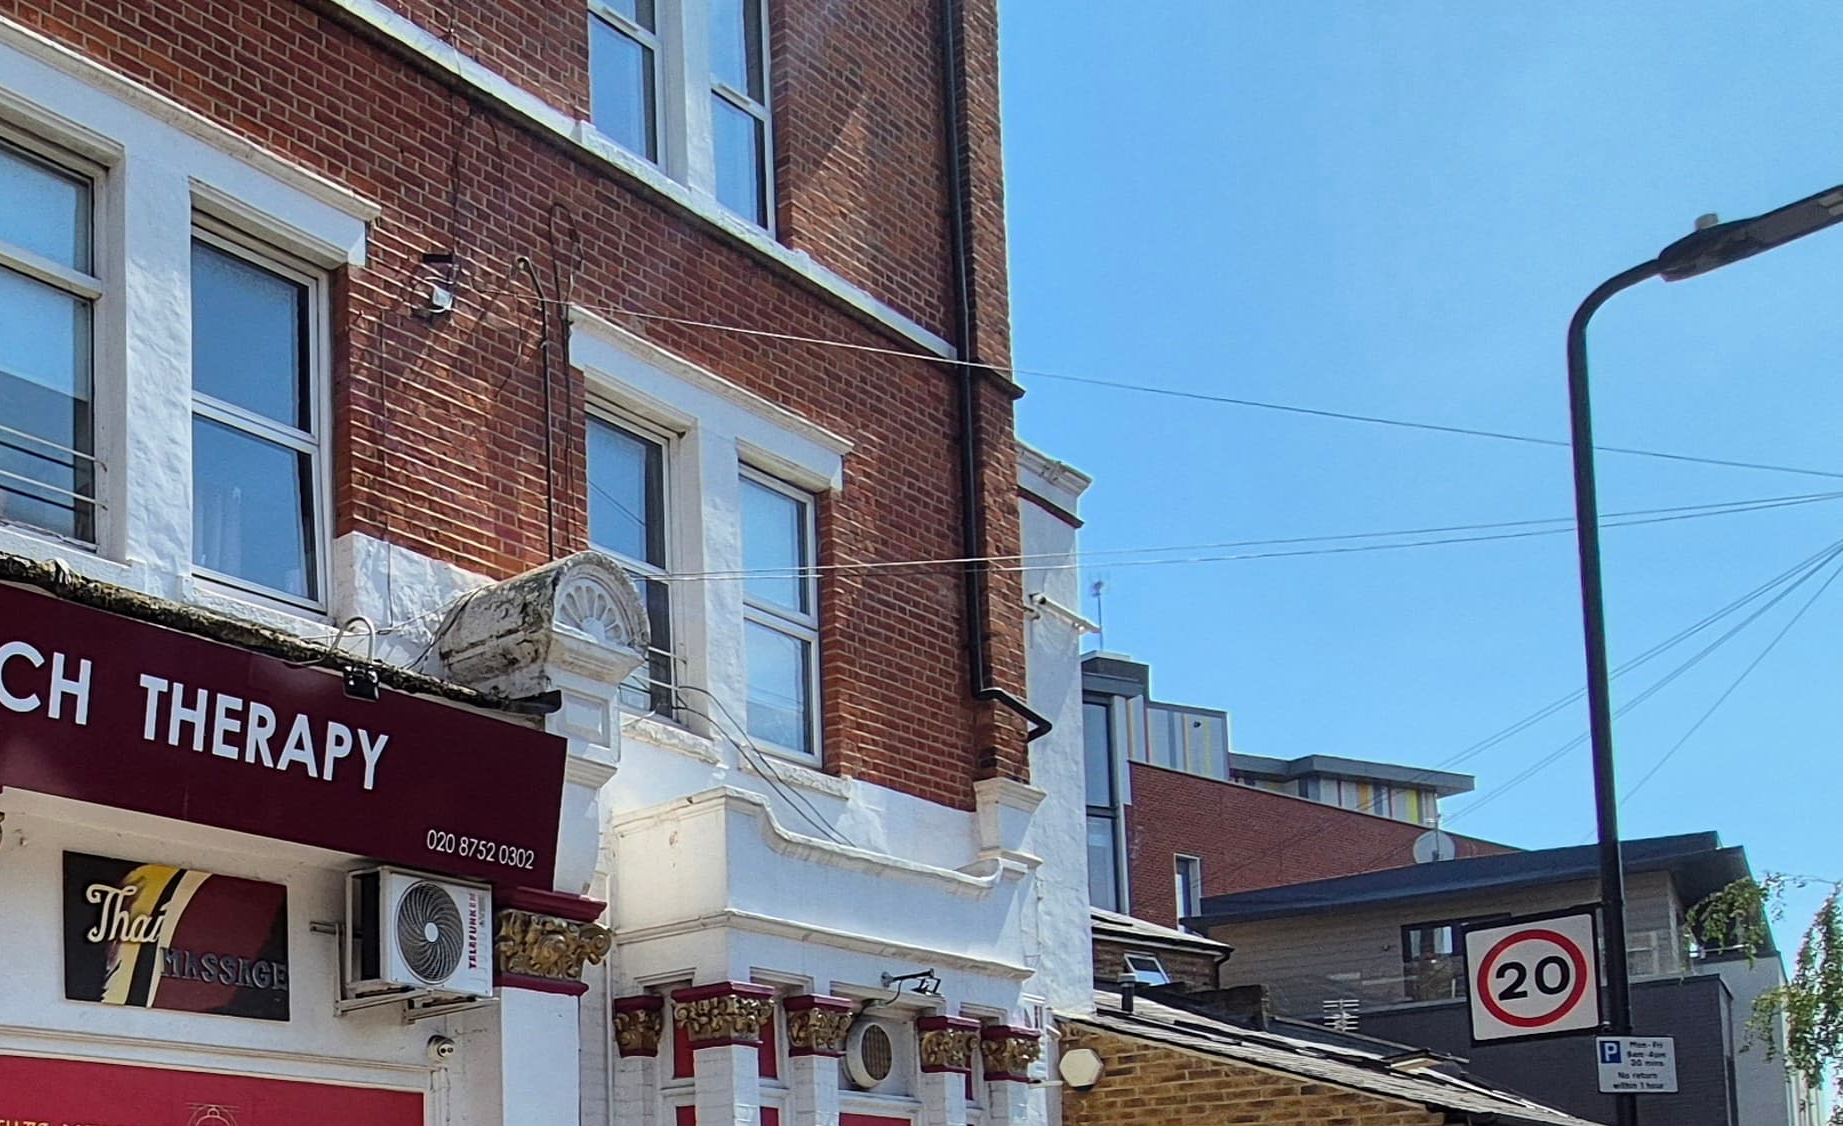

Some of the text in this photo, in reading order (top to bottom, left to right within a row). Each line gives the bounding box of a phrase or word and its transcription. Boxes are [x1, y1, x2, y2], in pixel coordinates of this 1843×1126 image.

[140, 673, 390, 791] THERAPY
[426, 829, 535, 869] 020 8752 0302
[86, 883, 173, 944] Thai
[161, 947, 288, 991] MASSAGE
[1495, 955, 1570, 1001] 20
[1604, 1042, 1618, 1062] P
